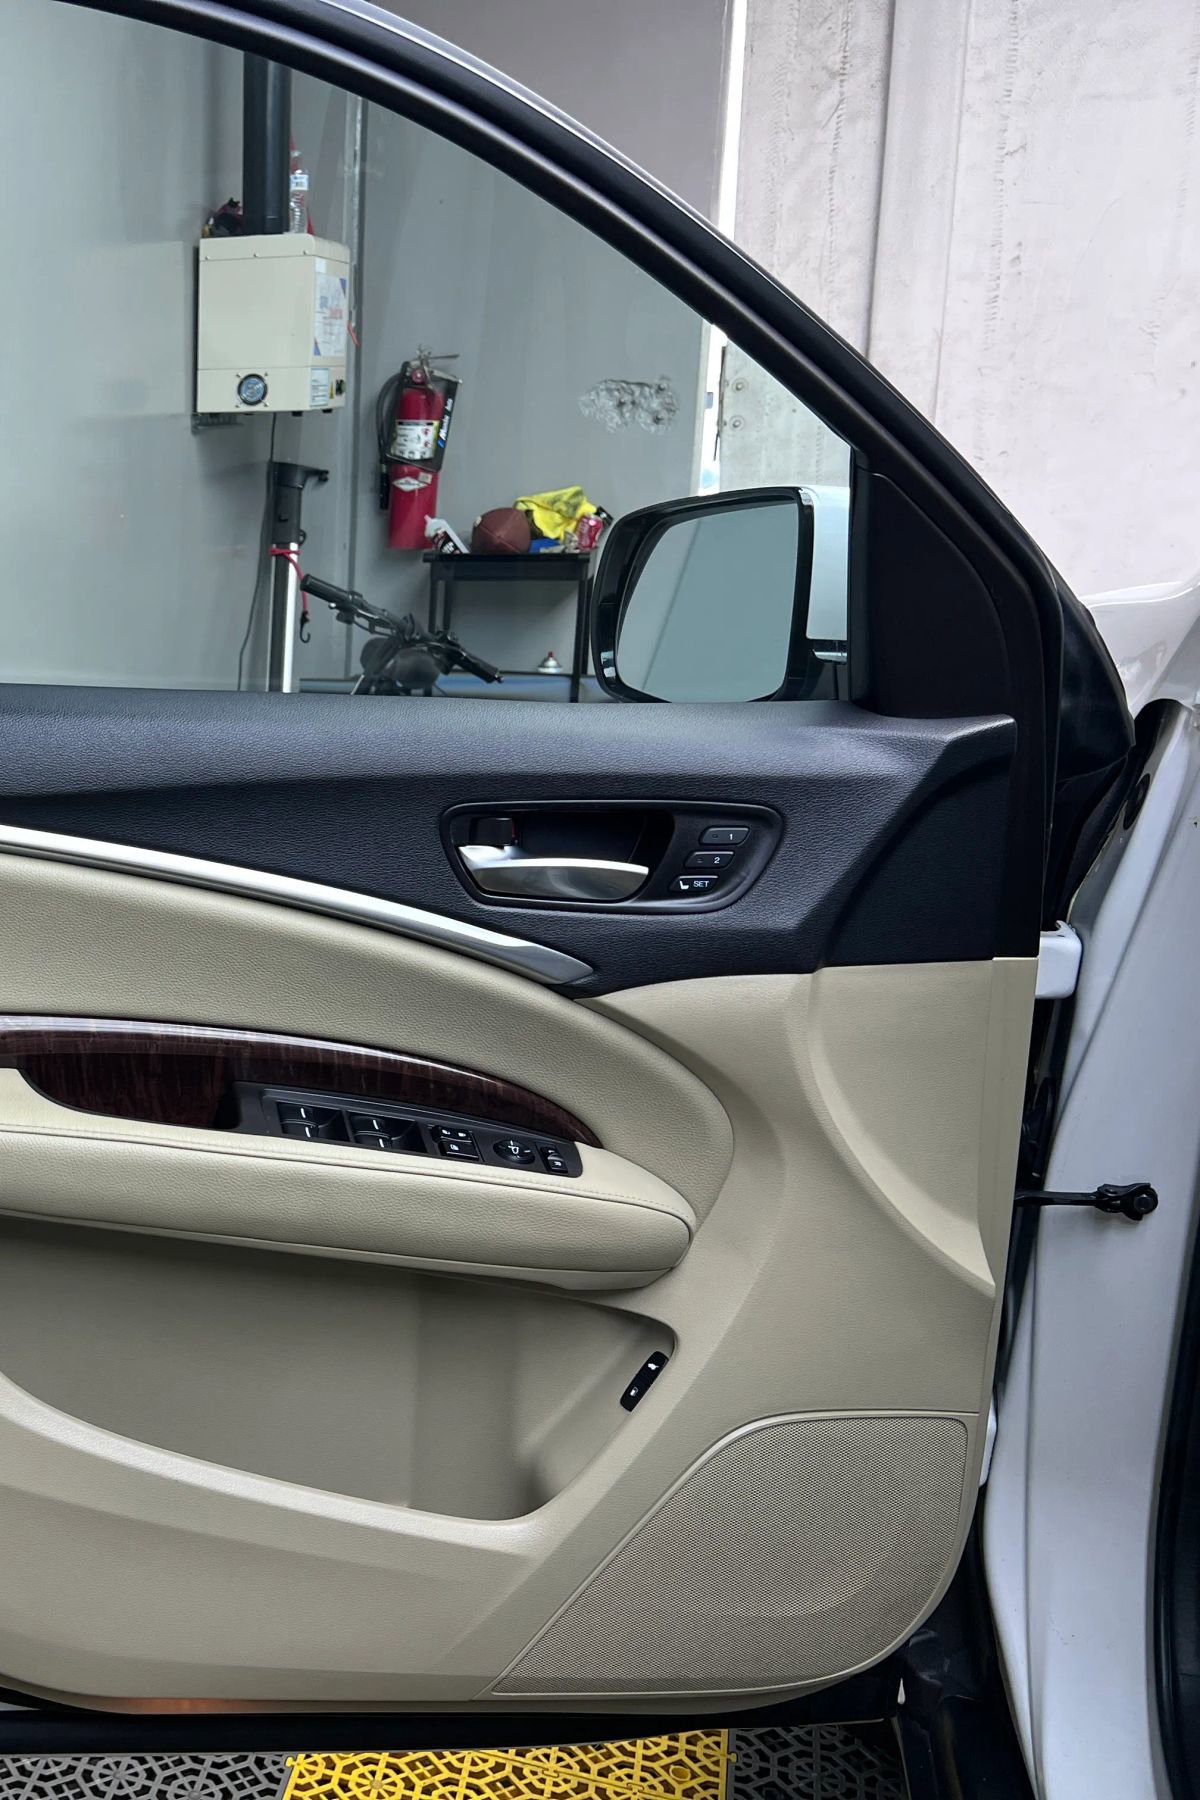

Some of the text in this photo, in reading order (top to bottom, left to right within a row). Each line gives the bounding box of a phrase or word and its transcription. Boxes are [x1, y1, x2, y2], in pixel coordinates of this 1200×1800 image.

[729, 833, 734, 841] 1
[713, 856, 721, 864] 2
[693, 880, 710, 888] SET
